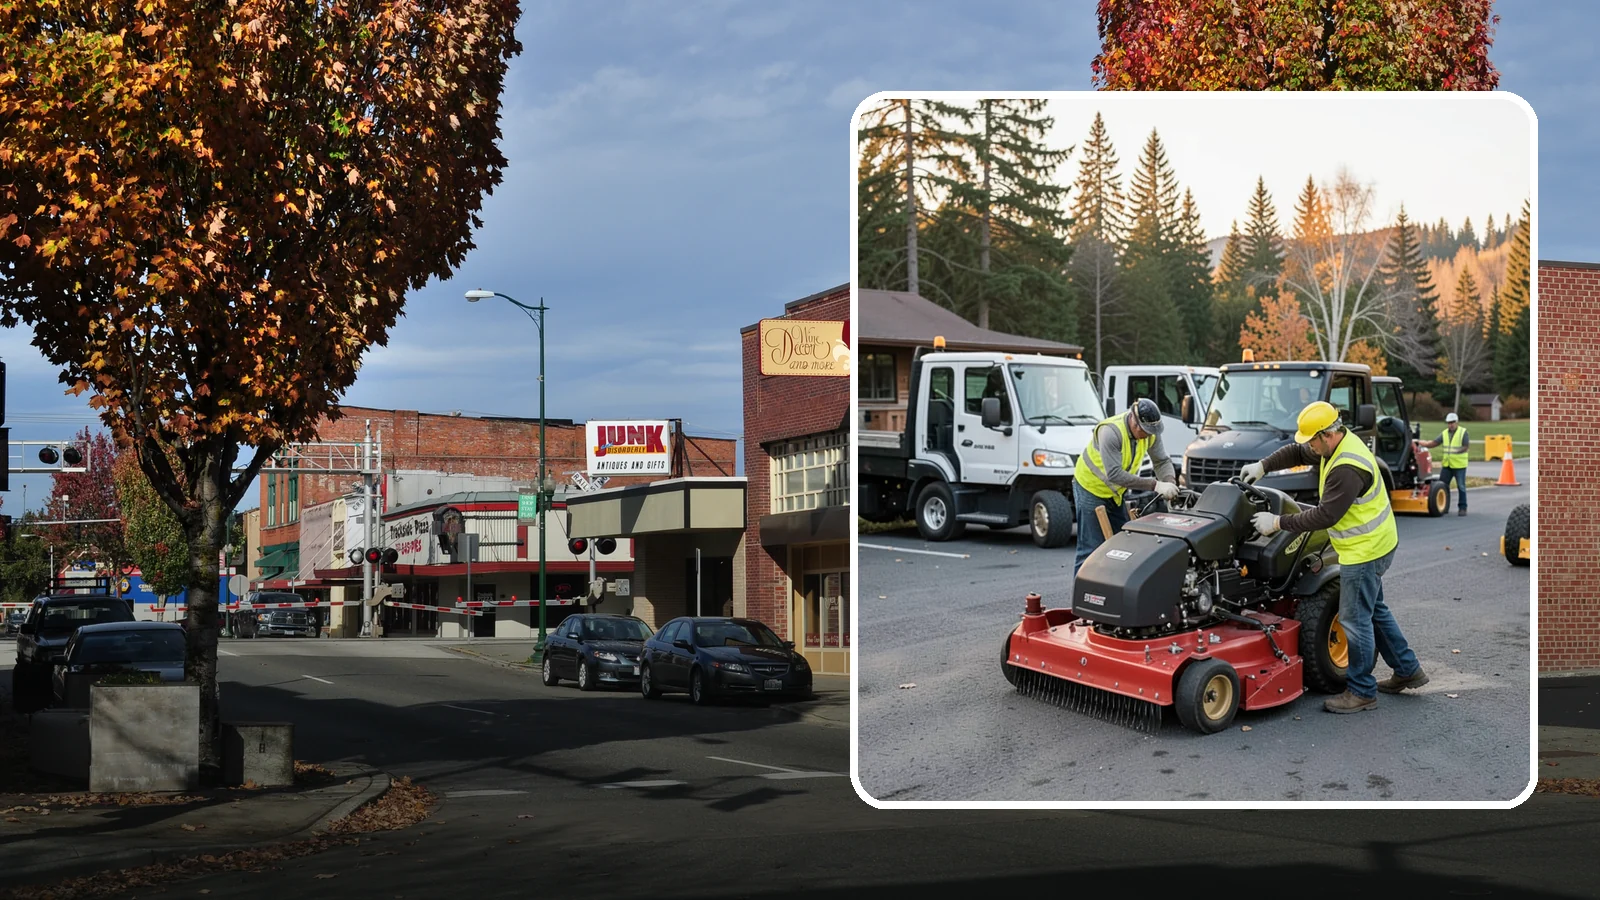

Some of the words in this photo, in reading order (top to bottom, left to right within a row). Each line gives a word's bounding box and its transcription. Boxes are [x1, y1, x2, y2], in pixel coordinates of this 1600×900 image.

[764, 327, 831, 365] Decor
[595, 425, 665, 457] JUNK
[607, 446, 646, 454] DISORDERLY
[597, 461, 628, 470] ANTIQUES
[631, 461, 644, 470] AND
[647, 460, 665, 469] GIFTS
[415, 519, 429, 535] Pizza
